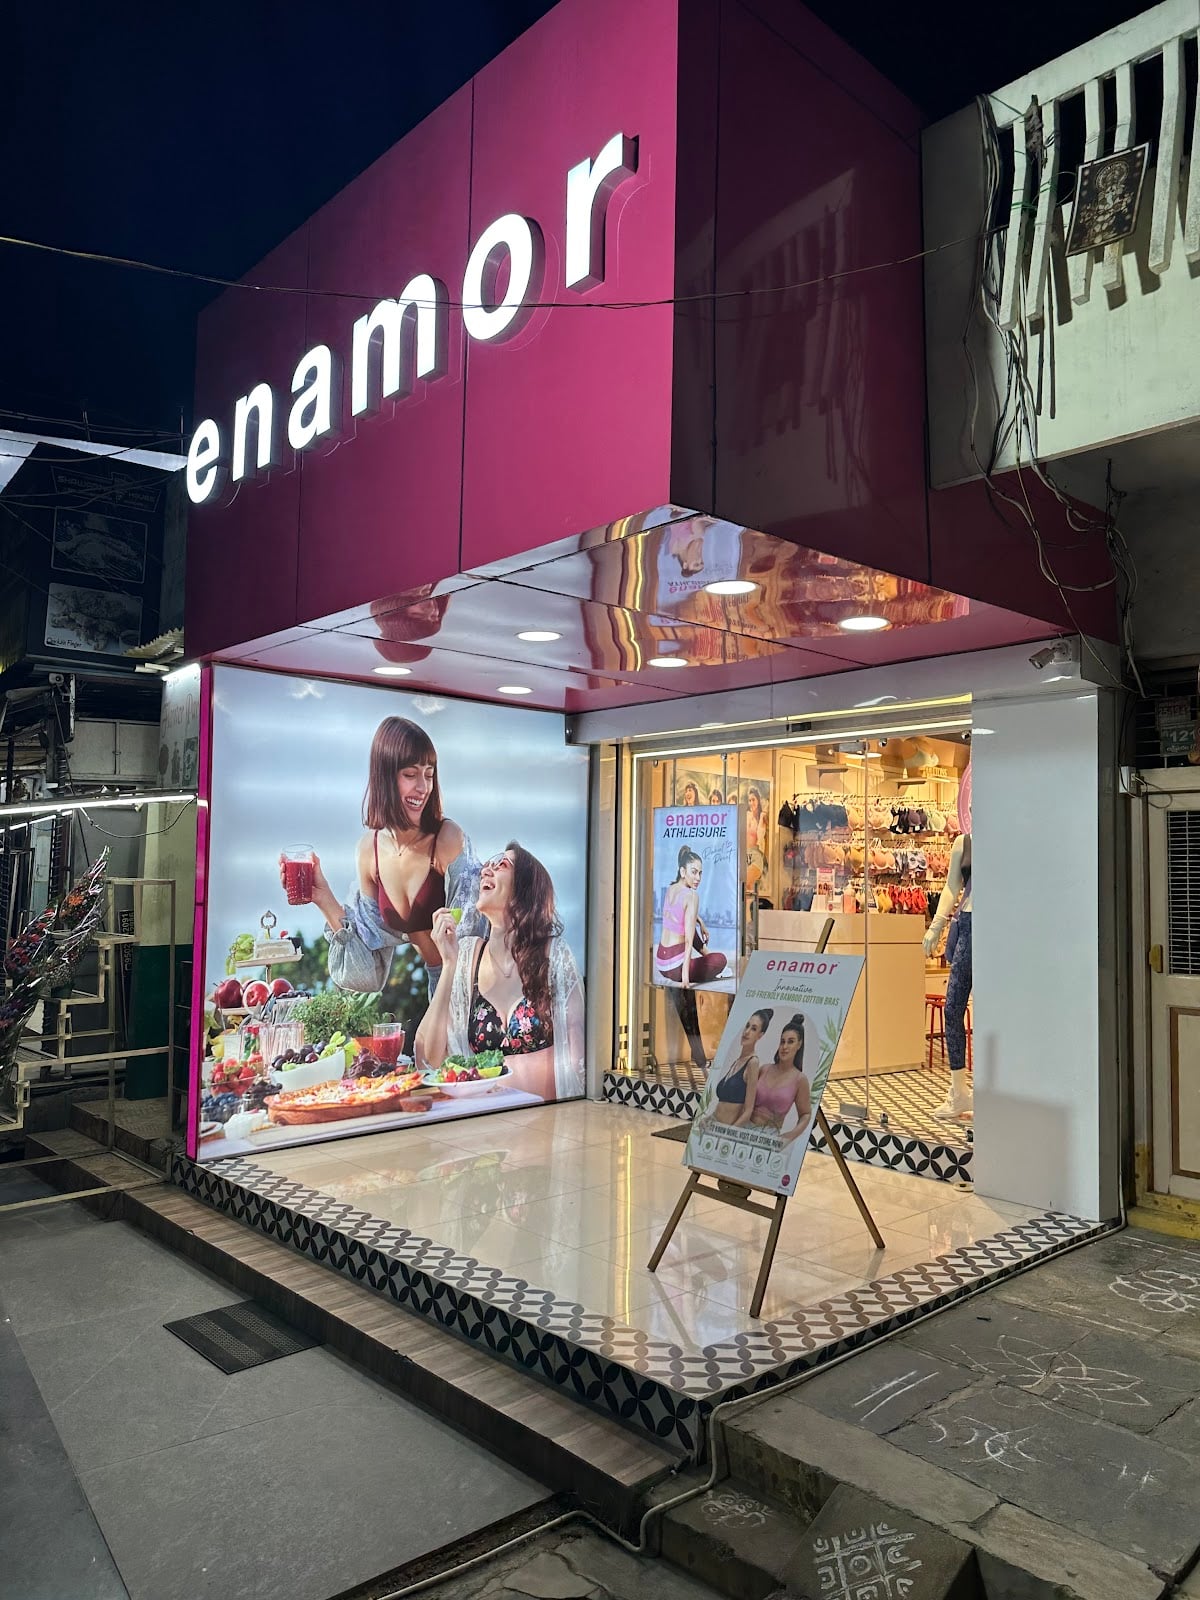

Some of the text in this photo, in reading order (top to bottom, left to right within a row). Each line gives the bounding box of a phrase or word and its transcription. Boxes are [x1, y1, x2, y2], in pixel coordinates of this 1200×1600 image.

[186, 132, 632, 504] enamor
[666, 812, 728, 827] enamor
[663, 826, 727, 838] ATHLEISURE
[766, 959, 838, 975] enamor
[774, 978, 813, 993] Innovative
[779, 992, 802, 1003] BAMBOO
[802, 994, 824, 1005] COTTON
[823, 997, 840, 1007] BRAS
[758, 1136, 772, 1146] STORE
